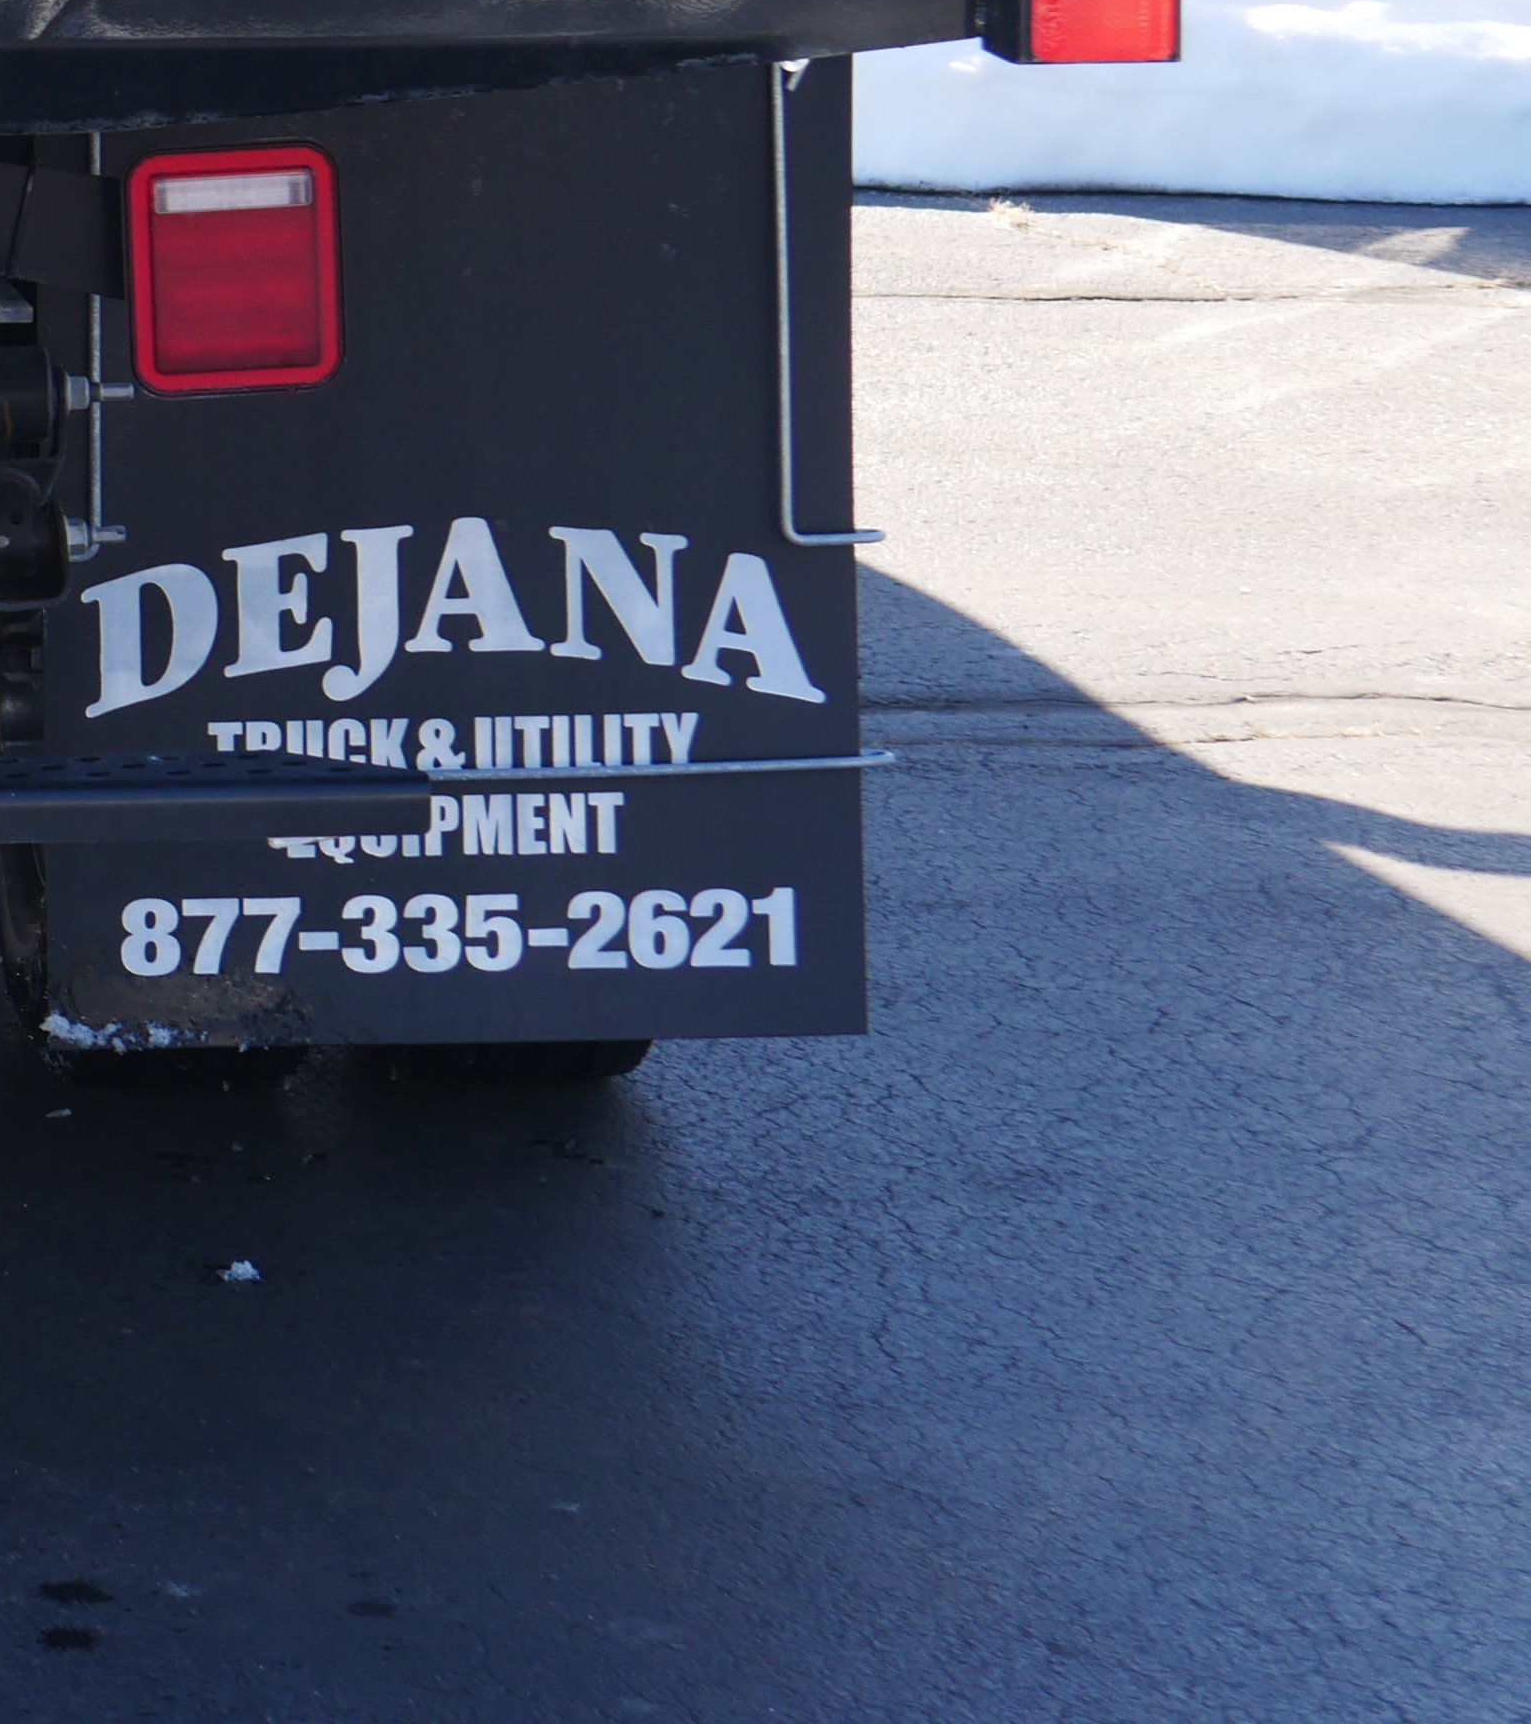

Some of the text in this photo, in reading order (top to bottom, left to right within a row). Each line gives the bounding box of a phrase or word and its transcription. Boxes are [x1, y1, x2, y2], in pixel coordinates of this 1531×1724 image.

[81, 517, 826, 718] DEJANA
[416, 718, 466, 771] &
[474, 712, 700, 770] UTILITY
[287, 792, 625, 864] PMENT
[120, 887, 798, 978] 877-335-2621
